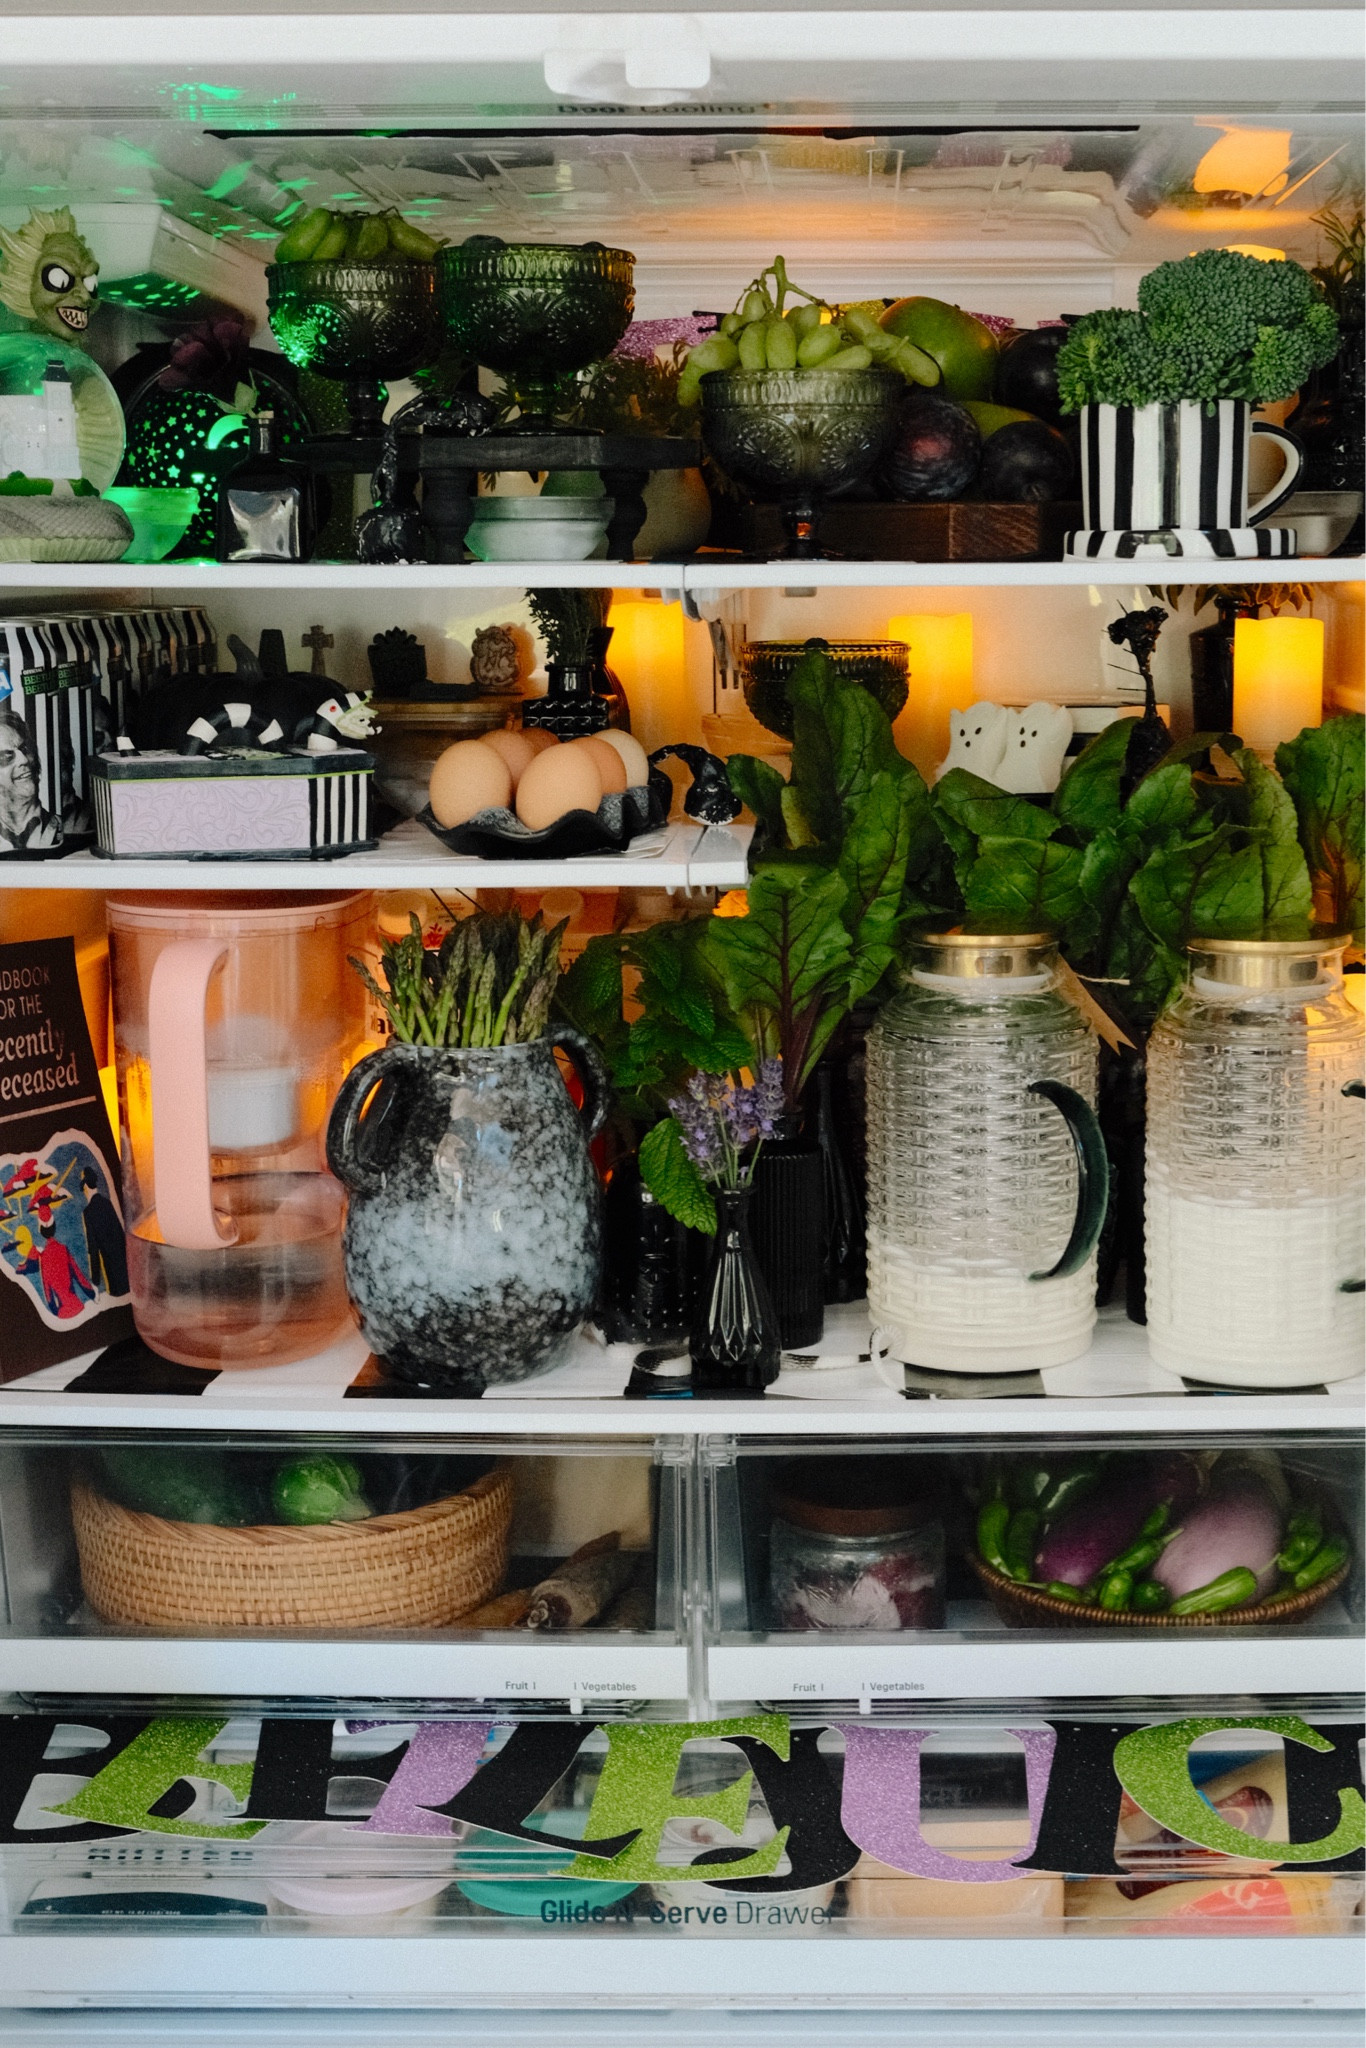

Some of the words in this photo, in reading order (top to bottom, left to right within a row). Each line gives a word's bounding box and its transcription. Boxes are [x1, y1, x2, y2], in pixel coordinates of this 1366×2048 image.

[0, 966, 49, 991] DBOOK
[19, 994, 43, 1016] THE
[1, 1052, 80, 1101] eceased
[505, 1681, 528, 1690] Fruit
[581, 1682, 637, 1693] Vegetables
[793, 1683, 816, 1692] Fruit
[869, 1682, 925, 1693] Vegetables
[540, 1899, 605, 1924] Glide
[650, 1900, 727, 1924] Serve
[736, 1901, 832, 1924] Drawer
